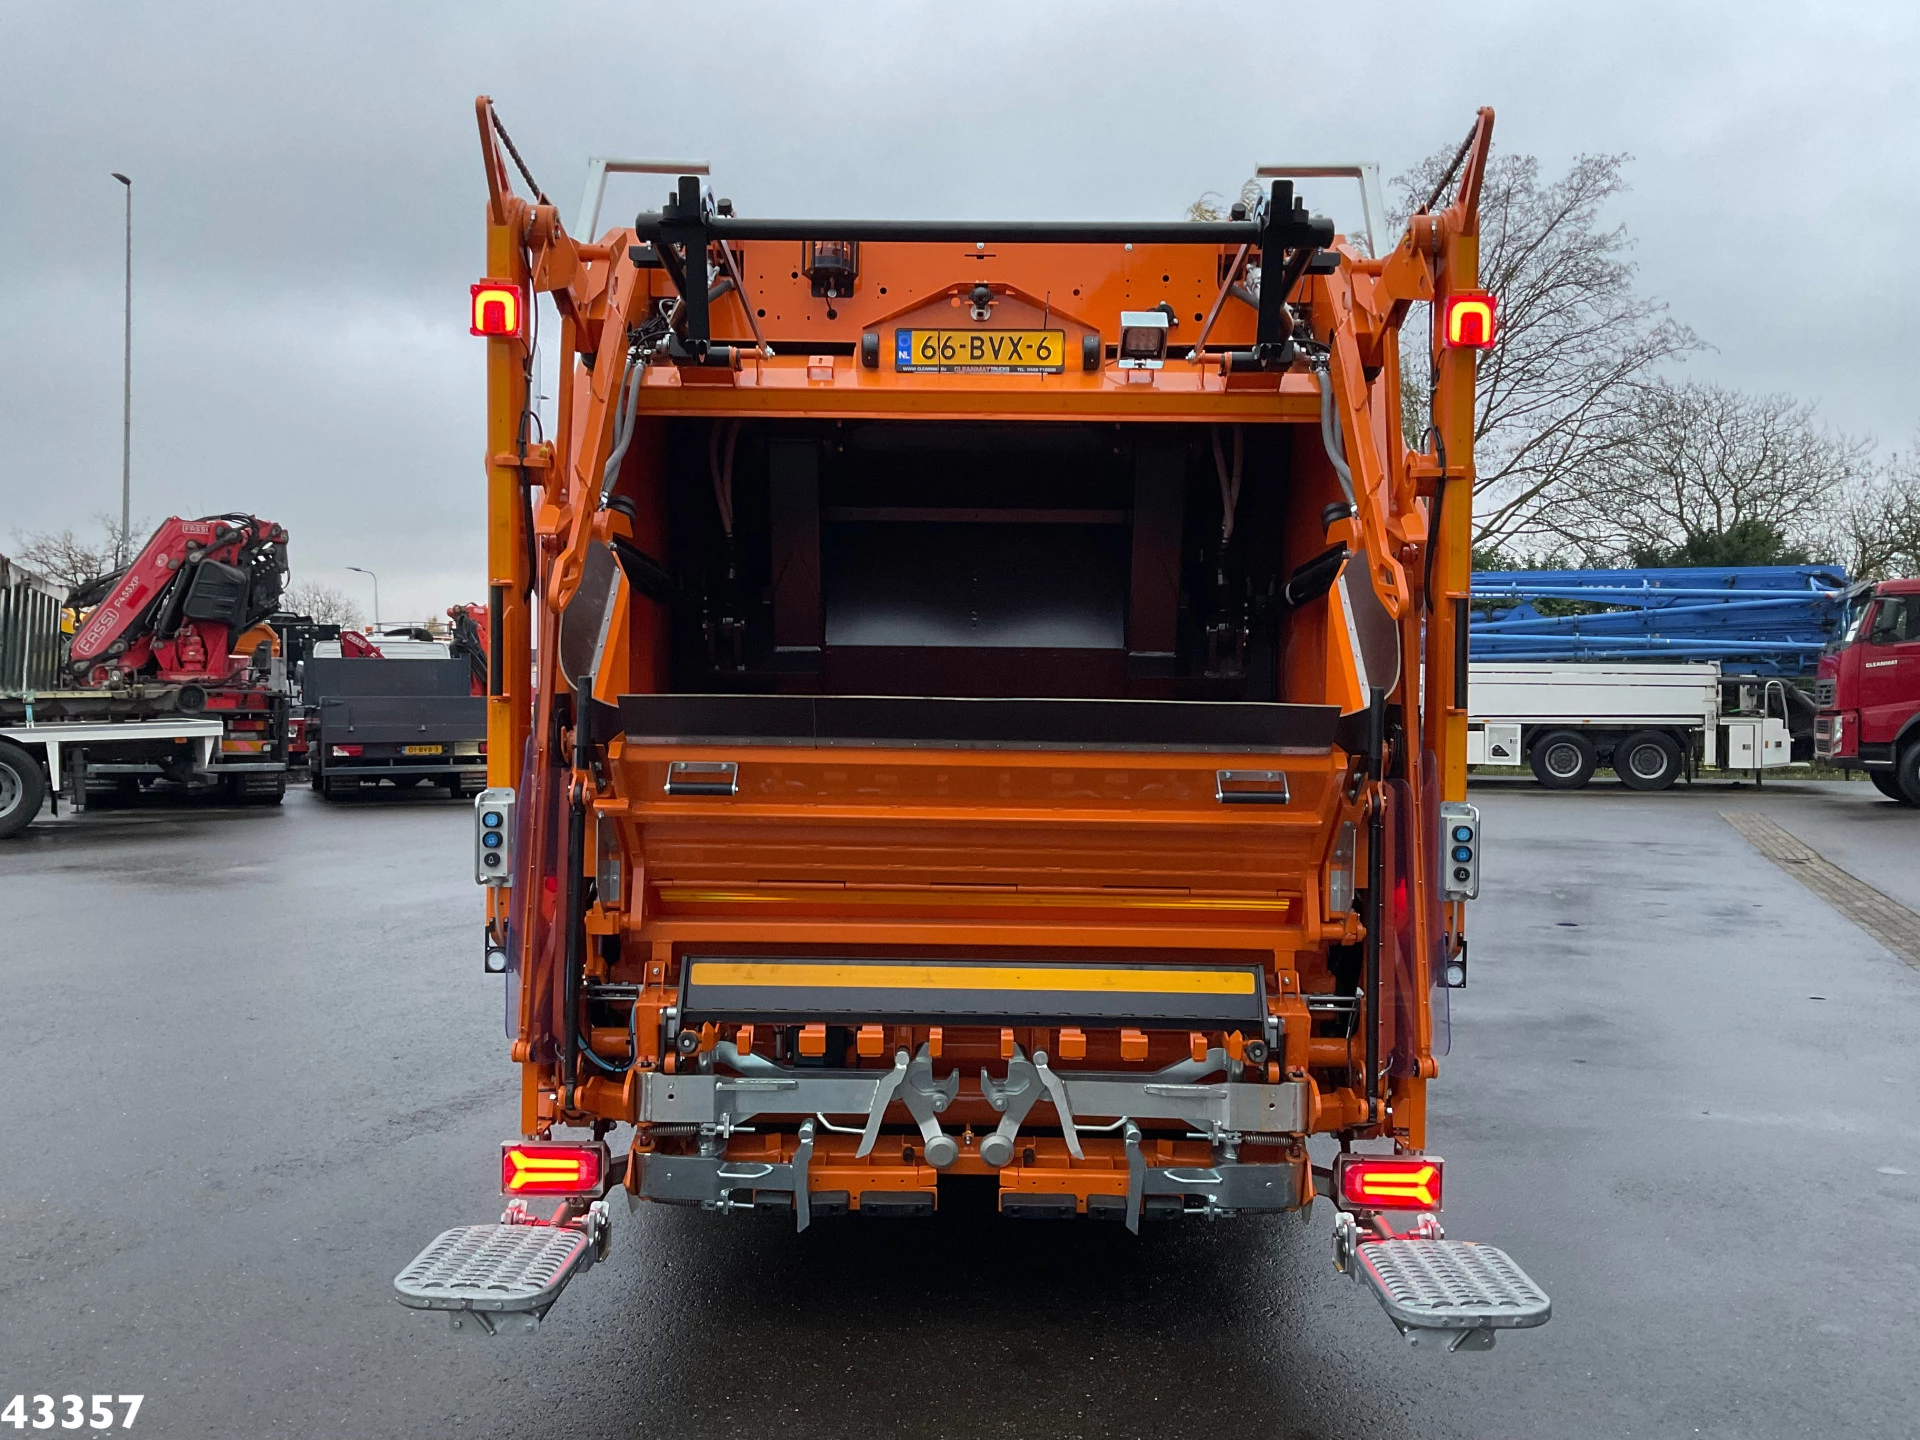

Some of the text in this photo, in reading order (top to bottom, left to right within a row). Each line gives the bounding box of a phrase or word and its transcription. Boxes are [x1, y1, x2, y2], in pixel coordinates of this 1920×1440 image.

[898, 335, 1052, 361] NL 66-BVX-6
[184, 525, 209, 533] FASSI
[79, 610, 118, 652] FASSI
[1865, 660, 1898, 668] CLEANMAT
